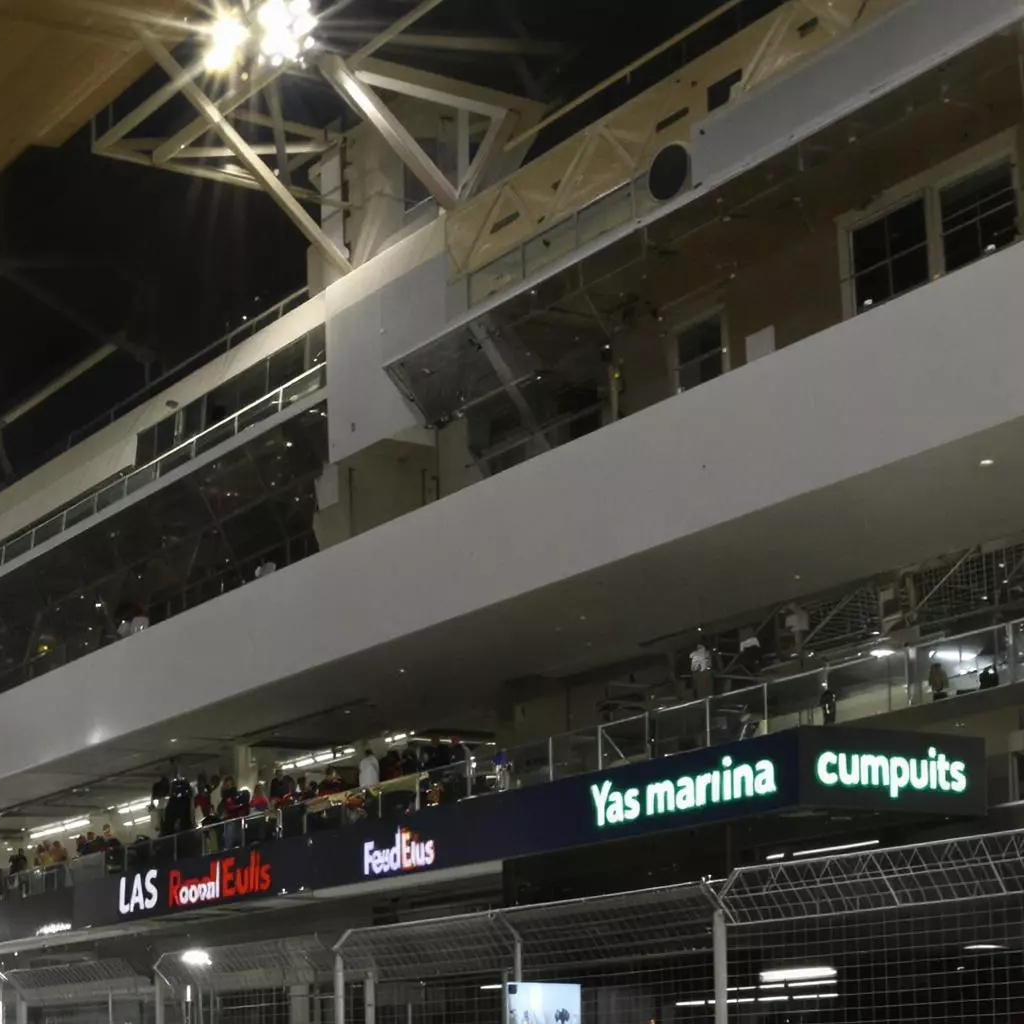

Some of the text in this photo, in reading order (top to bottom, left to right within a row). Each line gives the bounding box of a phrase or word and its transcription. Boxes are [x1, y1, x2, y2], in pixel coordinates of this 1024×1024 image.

[817, 746, 967, 798] cumpuits
[590, 780, 640, 826] Yas
[119, 869, 158, 914] LAS
